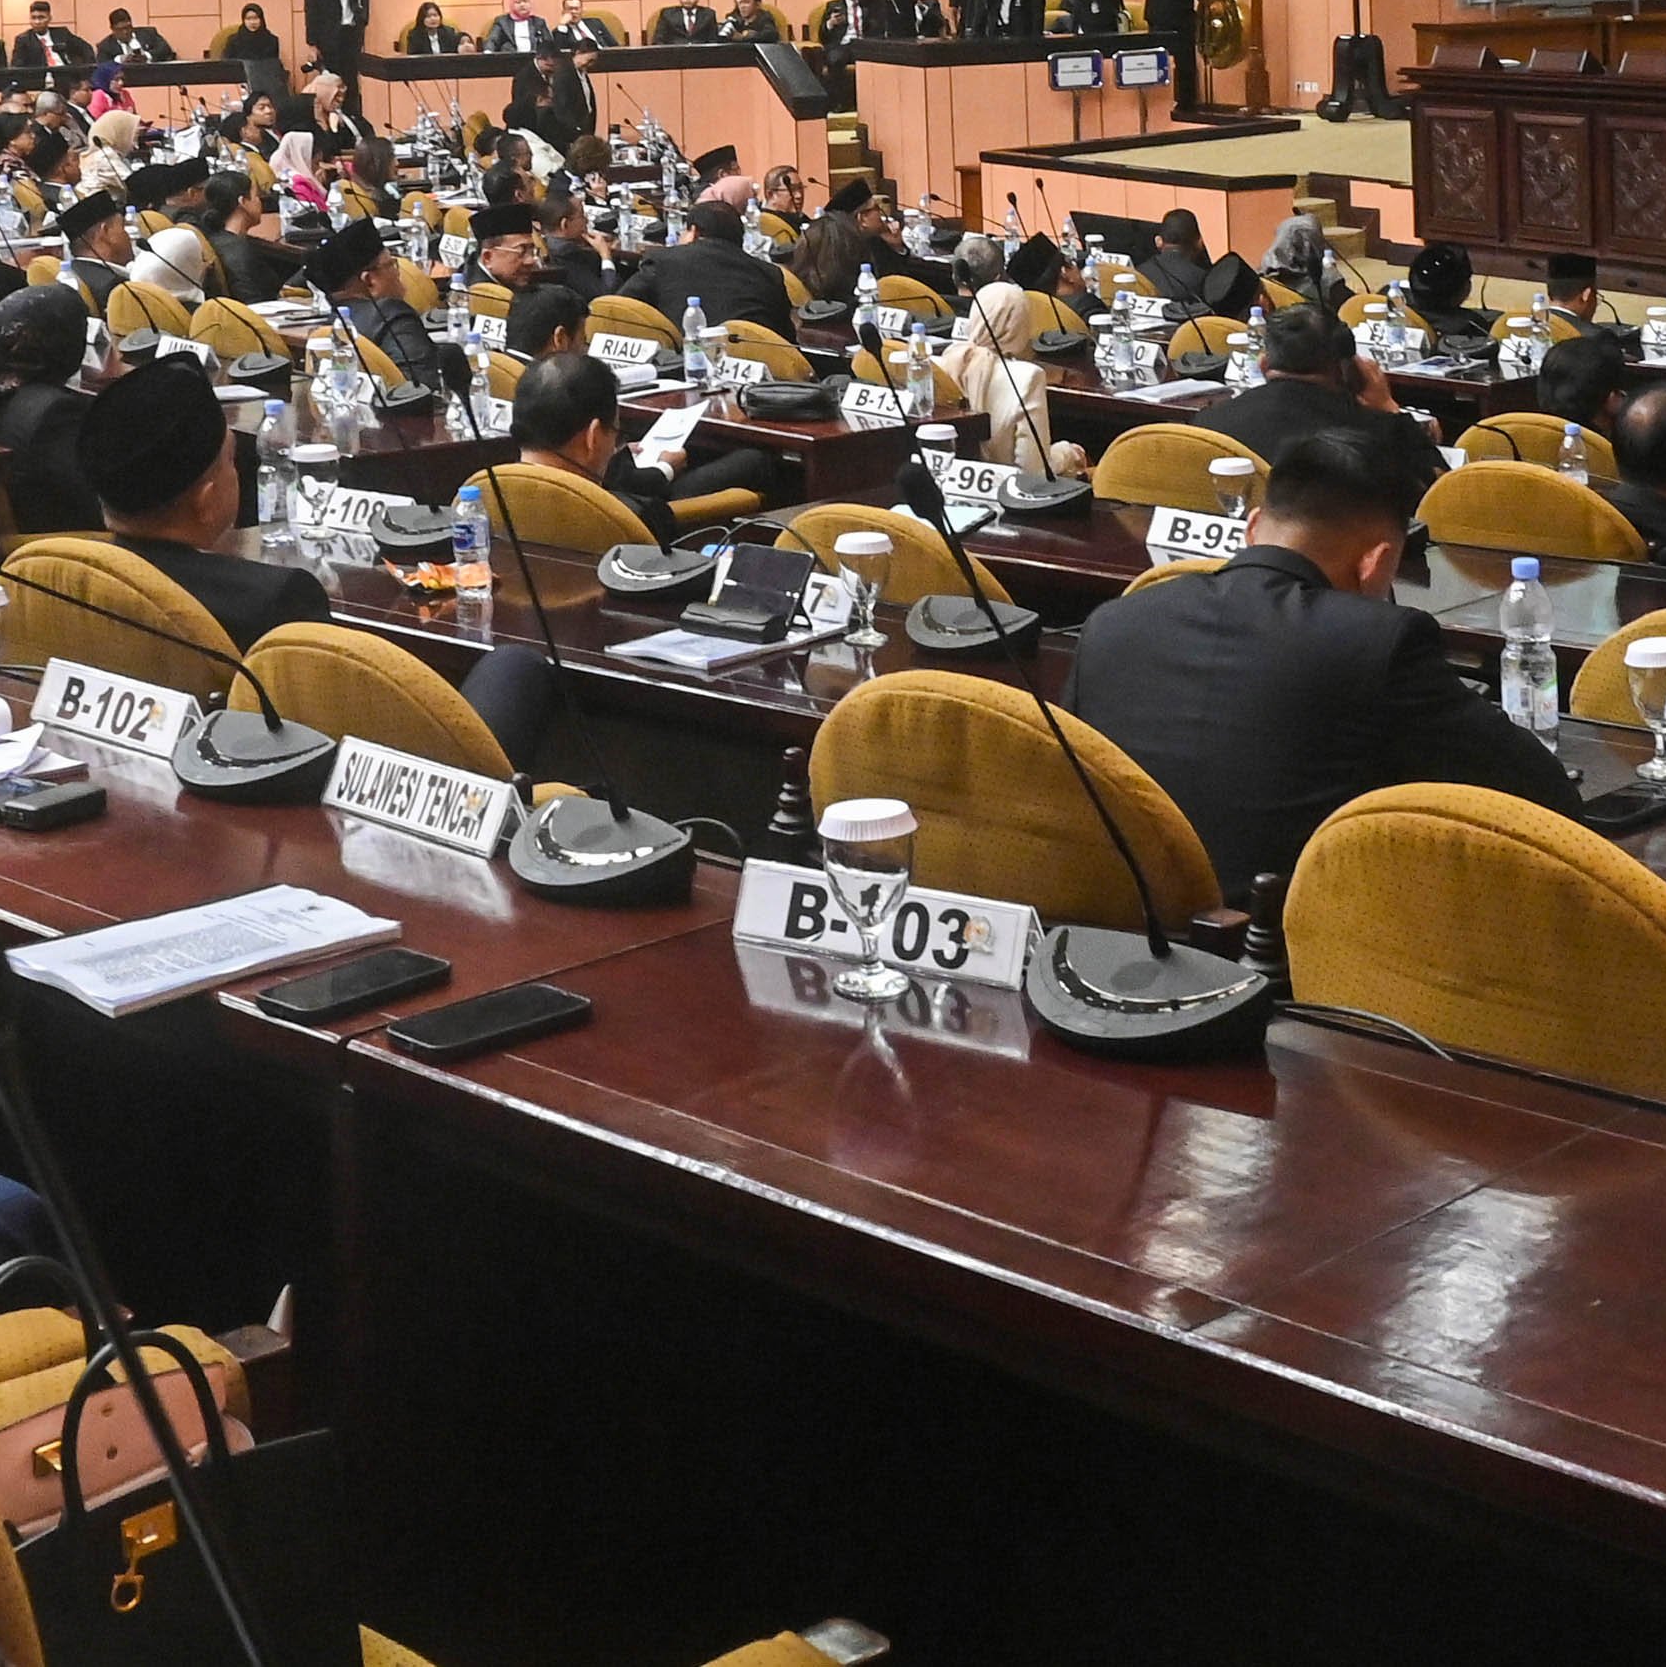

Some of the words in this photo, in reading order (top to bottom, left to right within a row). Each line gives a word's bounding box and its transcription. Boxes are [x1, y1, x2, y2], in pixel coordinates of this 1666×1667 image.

[482, 318, 506, 338] B-1
[602, 339, 642, 359] RIAU
[855, 389, 900, 413] B-13
[1167, 517, 1246, 555] B-95
[56, 676, 155, 742] B-102
[337, 751, 424, 821] SULAWESI
[418, 774, 494, 841] TENGAH
